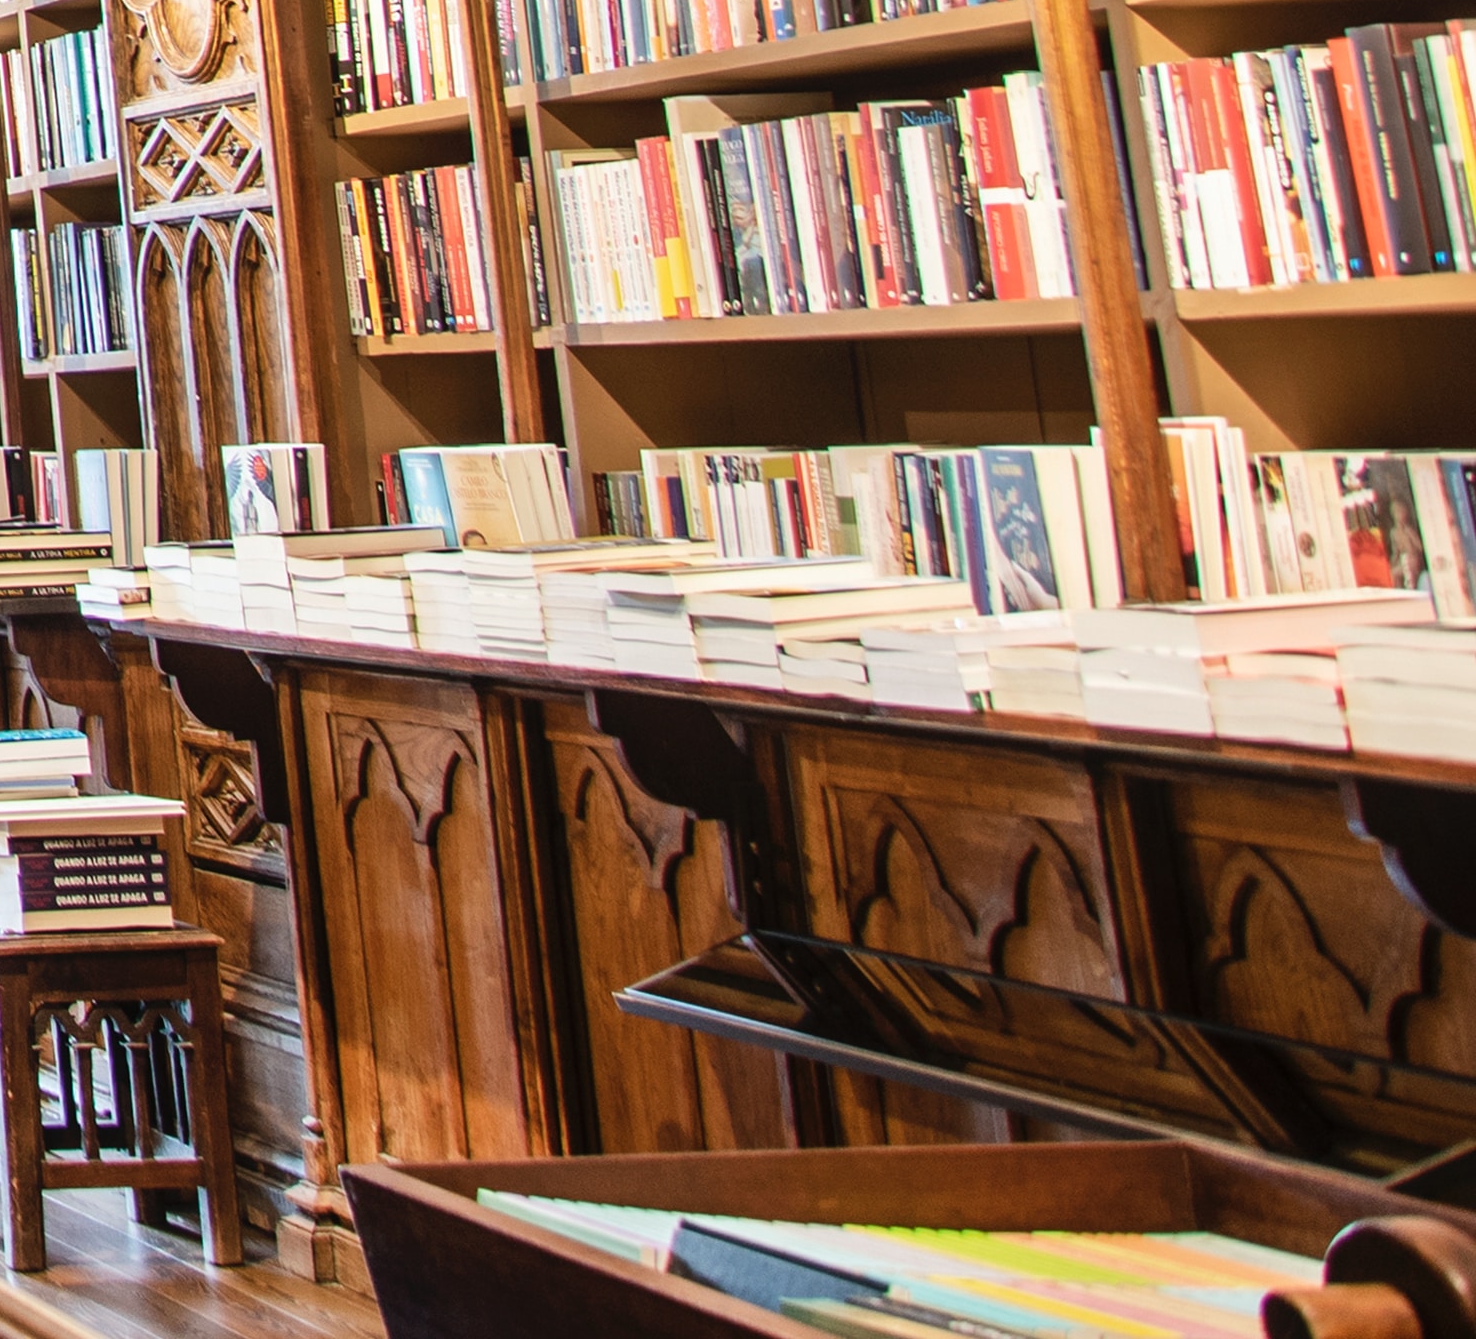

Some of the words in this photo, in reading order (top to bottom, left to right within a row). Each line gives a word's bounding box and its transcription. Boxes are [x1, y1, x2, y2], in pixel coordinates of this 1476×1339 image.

[414, 503, 444, 524] CASA
[54, 856, 85, 870] QUANDO
[119, 854, 147, 866] APAGA
[54, 875, 85, 889] QUANDO
[119, 873, 147, 885] APAGA
[56, 894, 88, 907] QUANDO
[121, 891, 149, 903] APAGA
